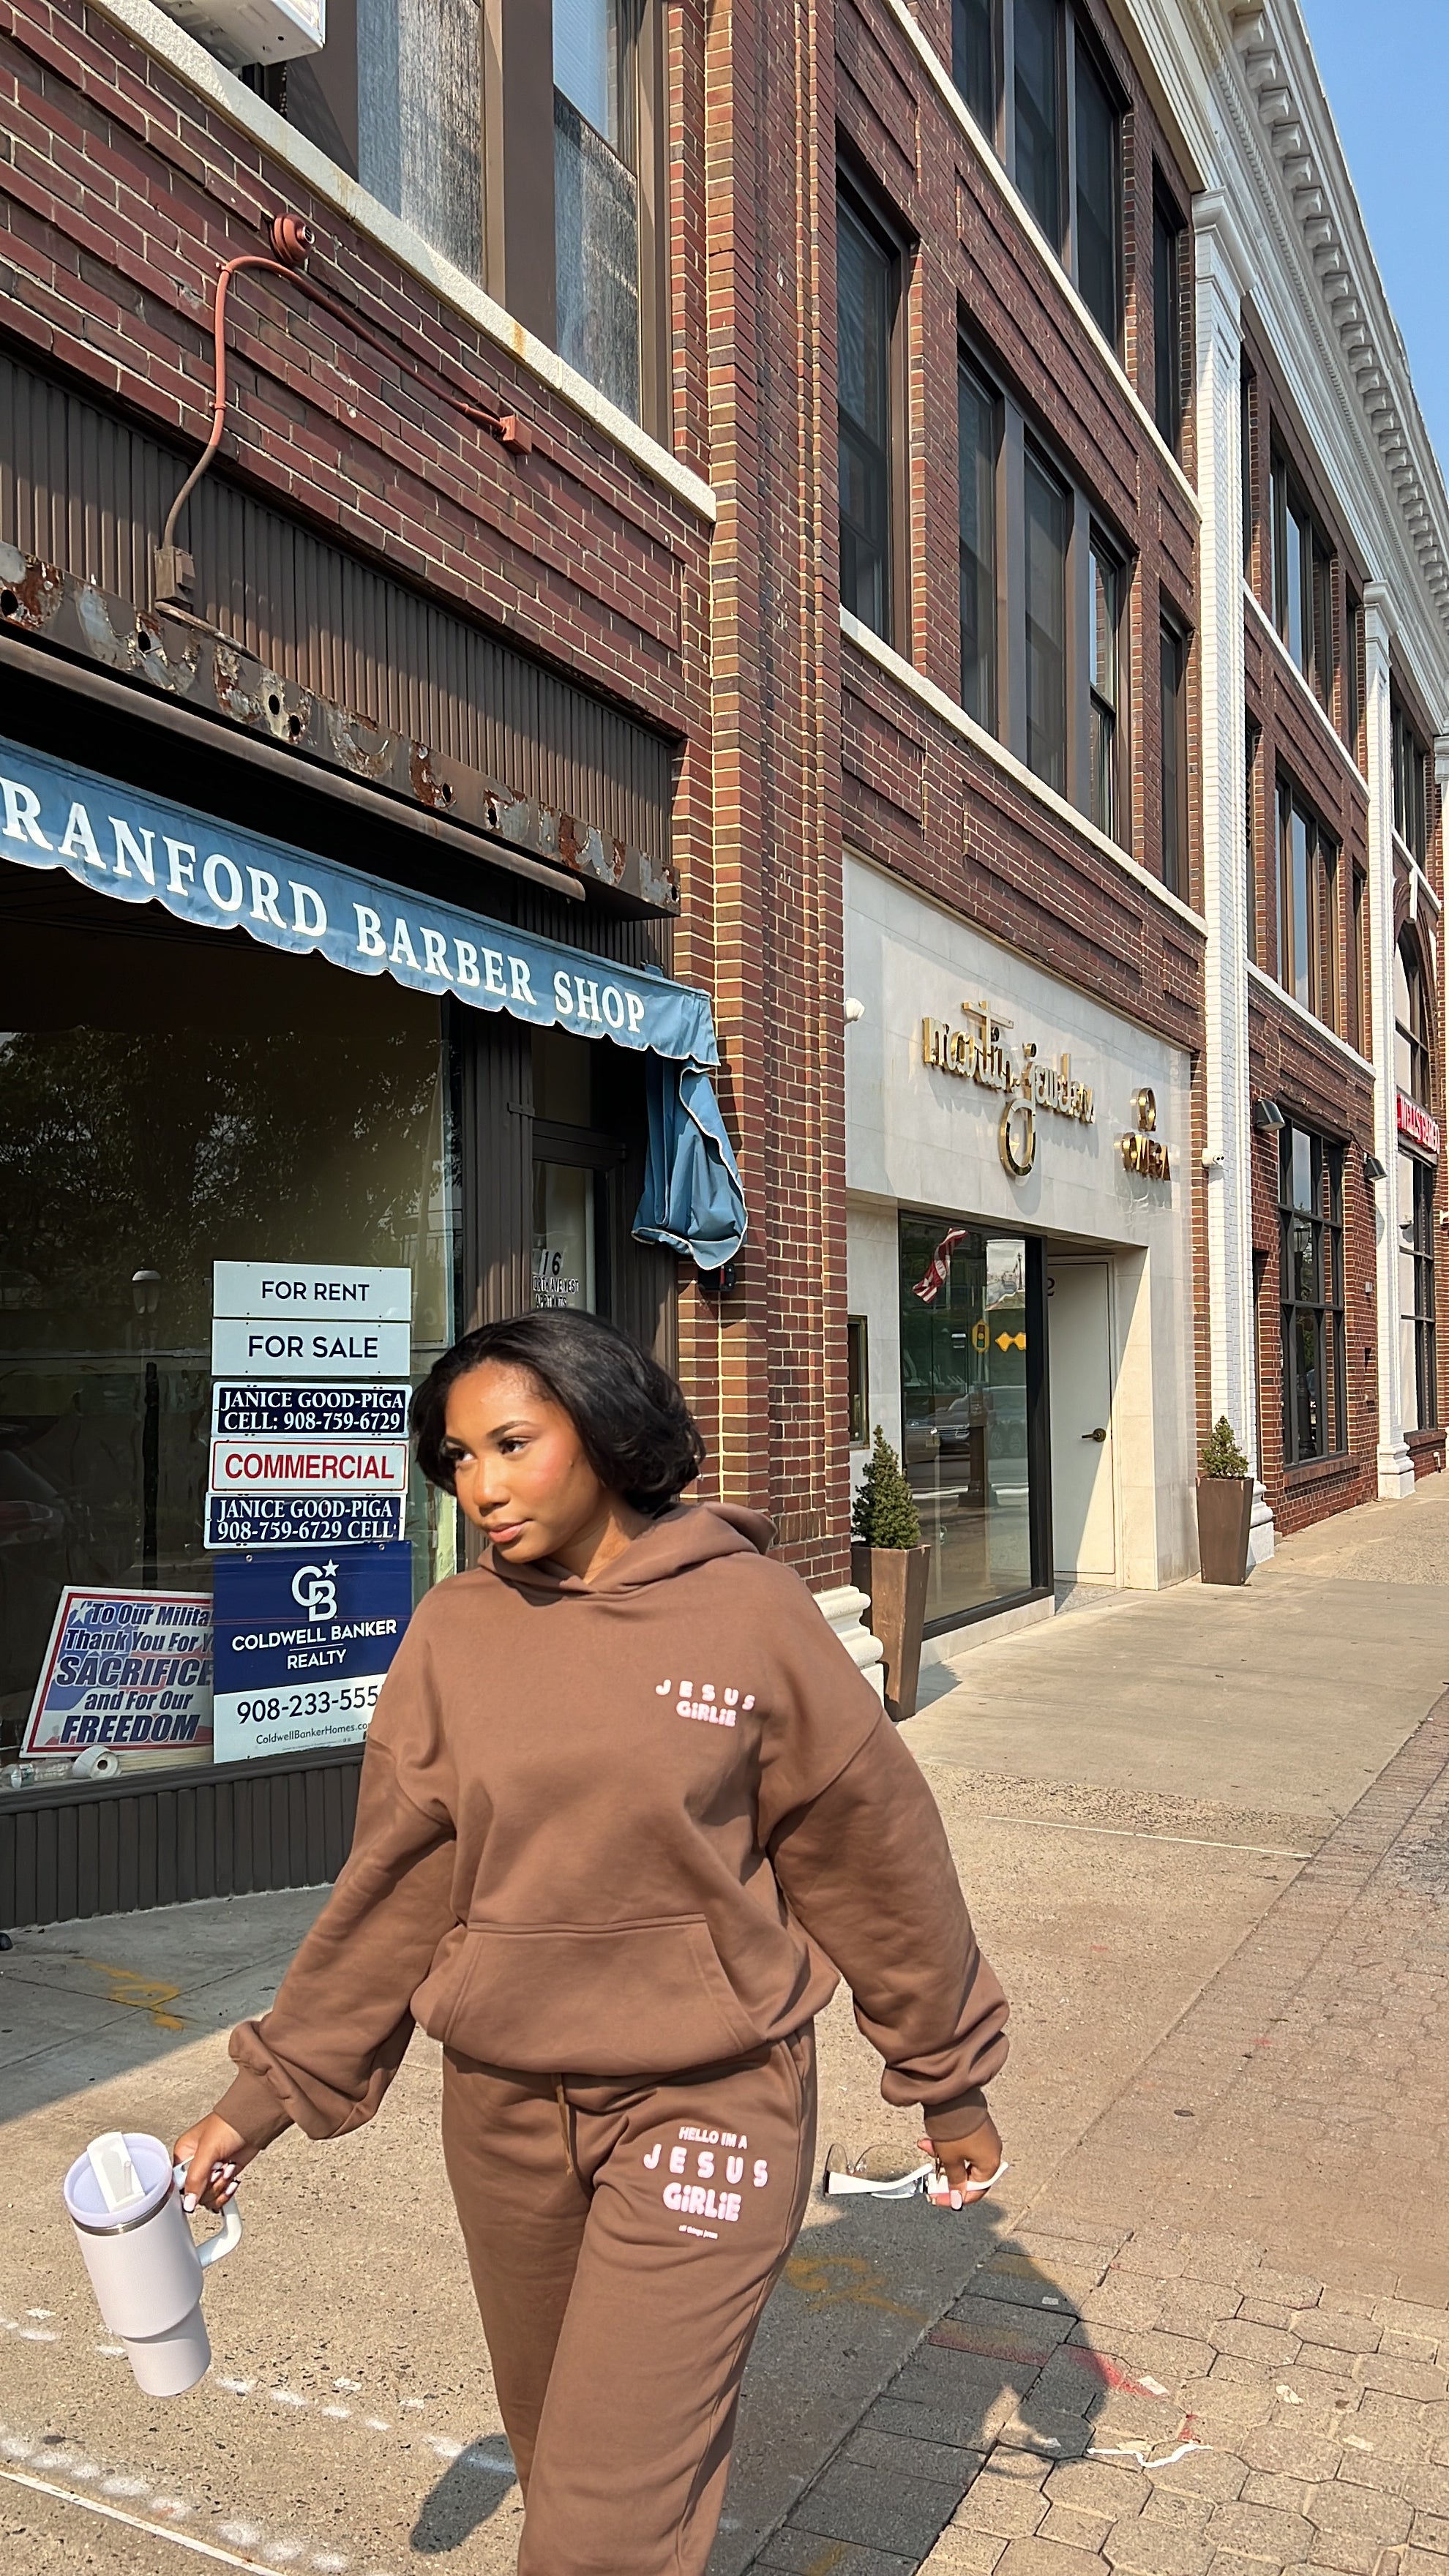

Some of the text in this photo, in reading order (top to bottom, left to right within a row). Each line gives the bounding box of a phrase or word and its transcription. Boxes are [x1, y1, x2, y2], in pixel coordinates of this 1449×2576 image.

[0, 777, 645, 1033] RANFORD BARBER SHOP
[542, 1251, 561, 1276] 16
[262, 1281, 370, 1300] FOR RENT
[249, 1335, 378, 1358] FOR SALE
[221, 1391, 404, 1411] JANICE GOOD-PIGA
[224, 1412, 400, 1430] CELL: 908-759-6729
[225, 1453, 394, 1479] COMMERCIAL
[217, 1500, 393, 1522] JANICE GOOD-PIGA
[217, 1521, 342, 1540] 908-759-6729
[292, 1565, 337, 1622] CB
[91, 1603, 213, 1626] To Our Milita
[66, 1629, 130, 1651] Thank
[131, 1631, 165, 1652] You
[168, 1633, 199, 1652] For
[232, 1619, 397, 1651] COLDWELL BANKER
[288, 1649, 347, 1669] REALTY
[84, 1690, 193, 1710] and For Our
[656, 1679, 755, 1710] JESUS
[60, 1714, 201, 1744] FREEDOM
[678, 2127, 719, 2144] HELLO
[738, 2135, 747, 2149] A
[643, 2143, 768, 2187] JESUS
